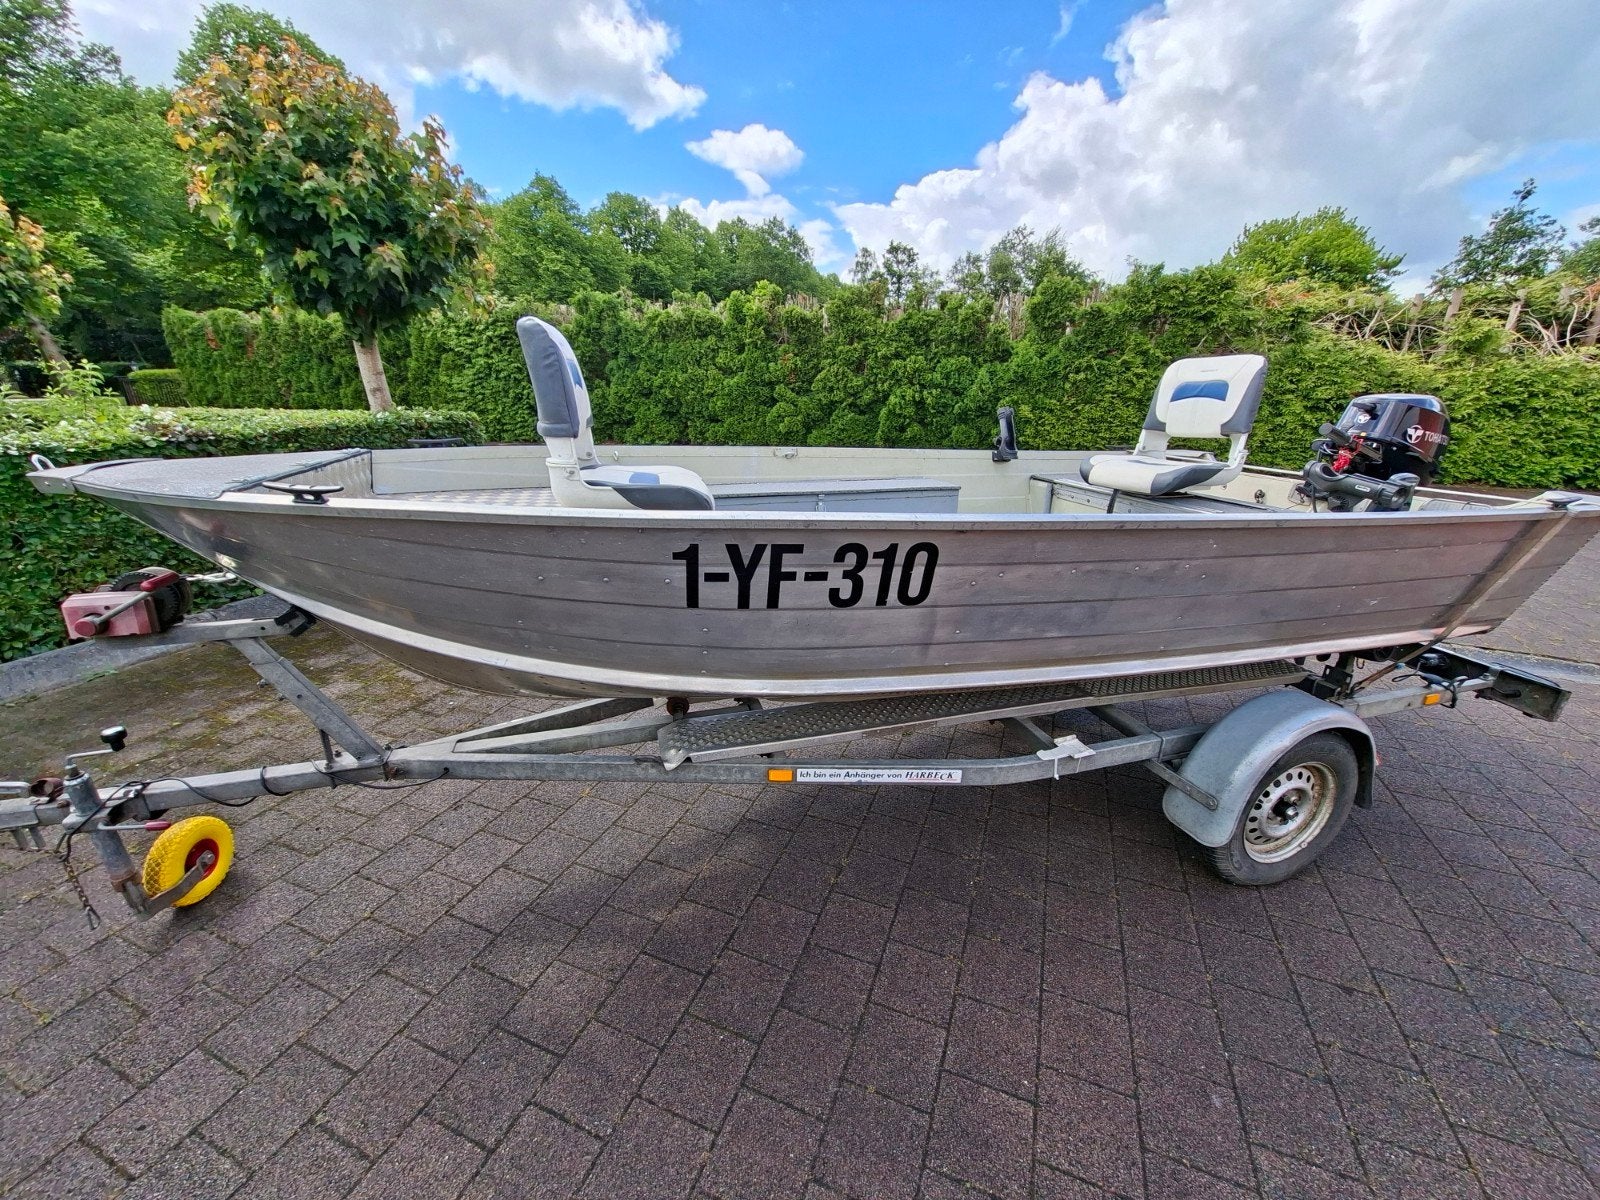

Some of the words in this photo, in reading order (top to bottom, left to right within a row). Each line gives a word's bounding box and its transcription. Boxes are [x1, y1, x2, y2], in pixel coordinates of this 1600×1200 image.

[672, 541, 939, 609] 1-YF-310
[843, 771, 884, 779] Anhänger
[905, 771, 954, 780] HARBECK
